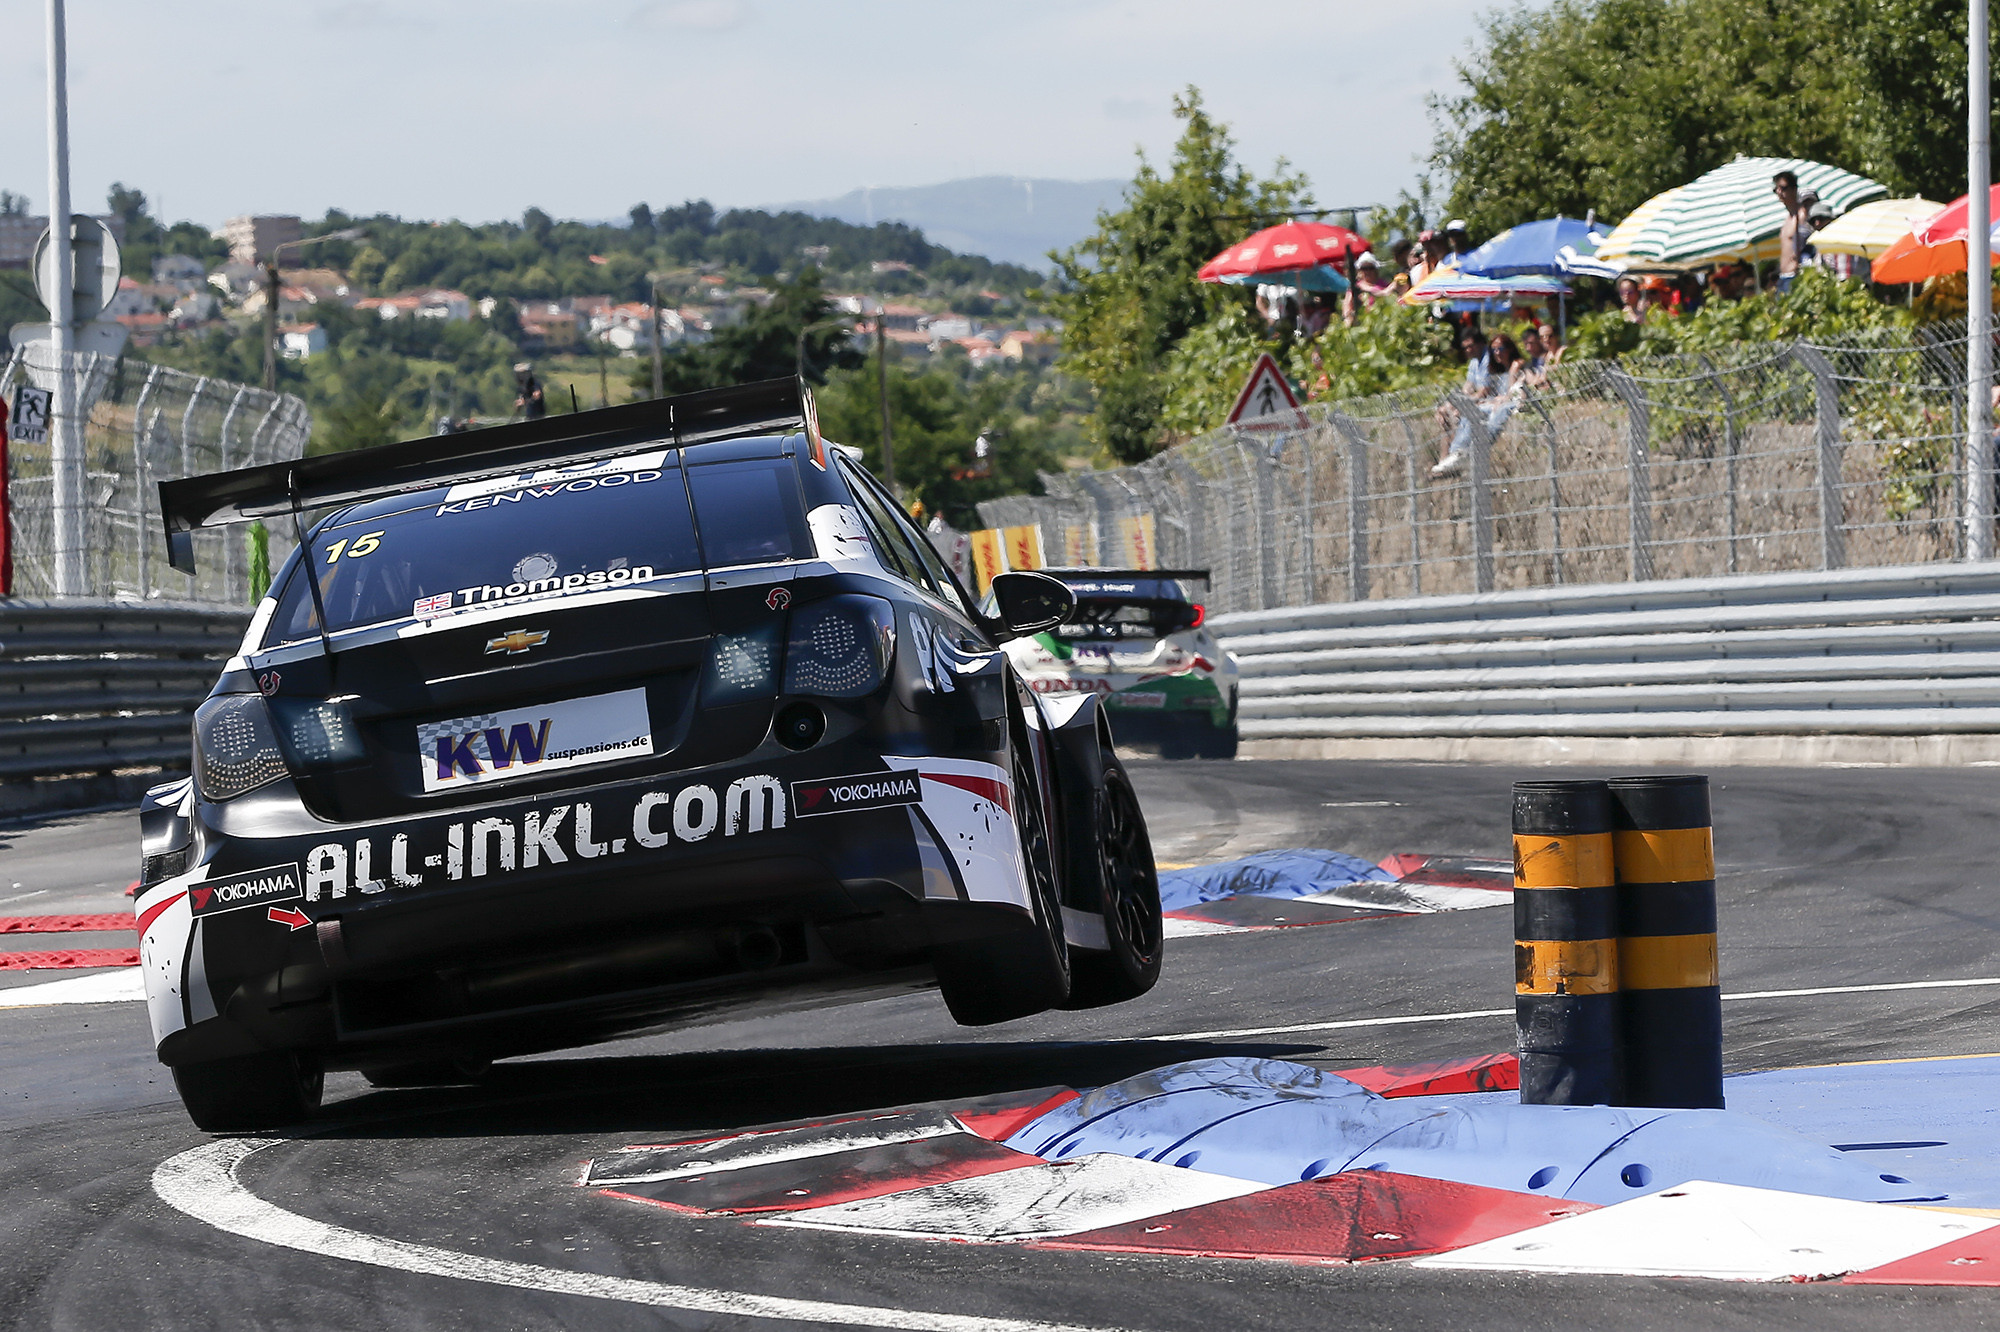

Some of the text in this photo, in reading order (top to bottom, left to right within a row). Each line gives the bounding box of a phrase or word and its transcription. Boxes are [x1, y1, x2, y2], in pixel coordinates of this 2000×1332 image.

[14, 425, 45, 440] EXIT
[435, 470, 663, 517] KENWOOD
[325, 530, 385, 564] 15
[457, 565, 654, 605] Thompson
[1026, 678, 1113, 693] ONDA
[436, 717, 648, 781] KW suspensions.de
[828, 779, 917, 803] YOKOHAMA
[306, 774, 786, 902] ALL-INKL.COM
[213, 873, 296, 903] YOKOHAMA
